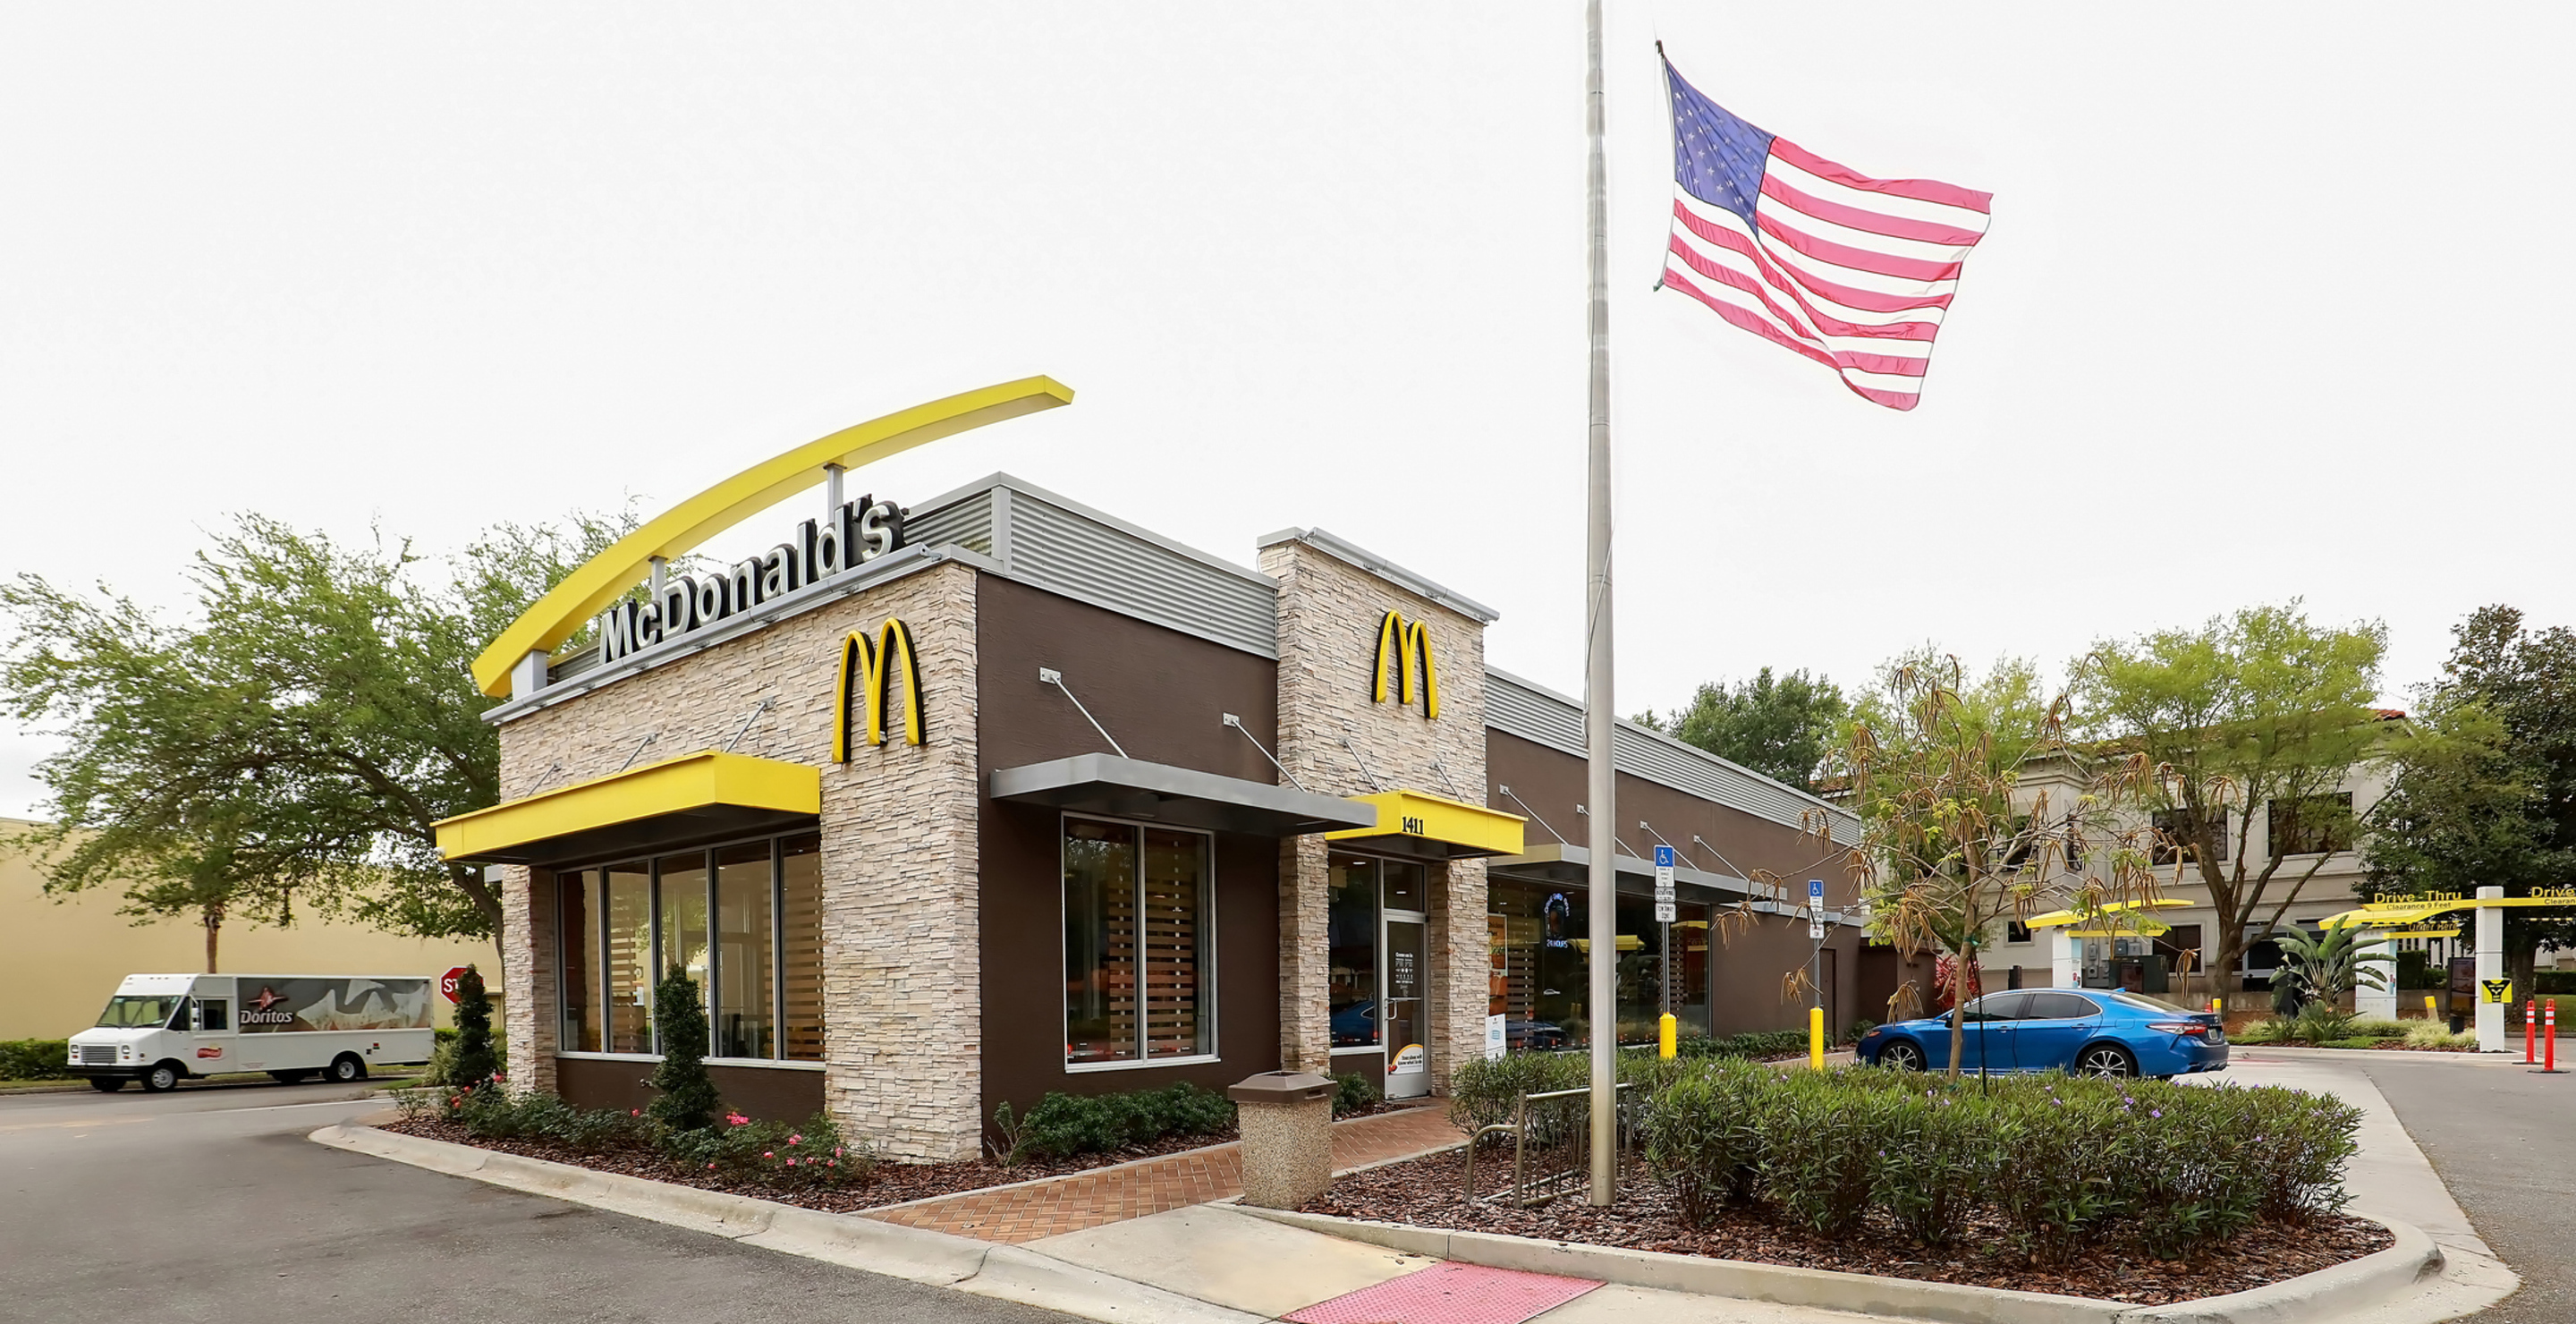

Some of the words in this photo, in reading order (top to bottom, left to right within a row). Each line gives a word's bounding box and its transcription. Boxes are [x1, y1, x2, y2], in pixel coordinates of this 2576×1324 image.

[598, 495, 903, 665] McDonald's
[1402, 816, 1424, 836] 1411
[2531, 887, 2575, 898] Drive
[240, 1009, 293, 1023] Doritos
